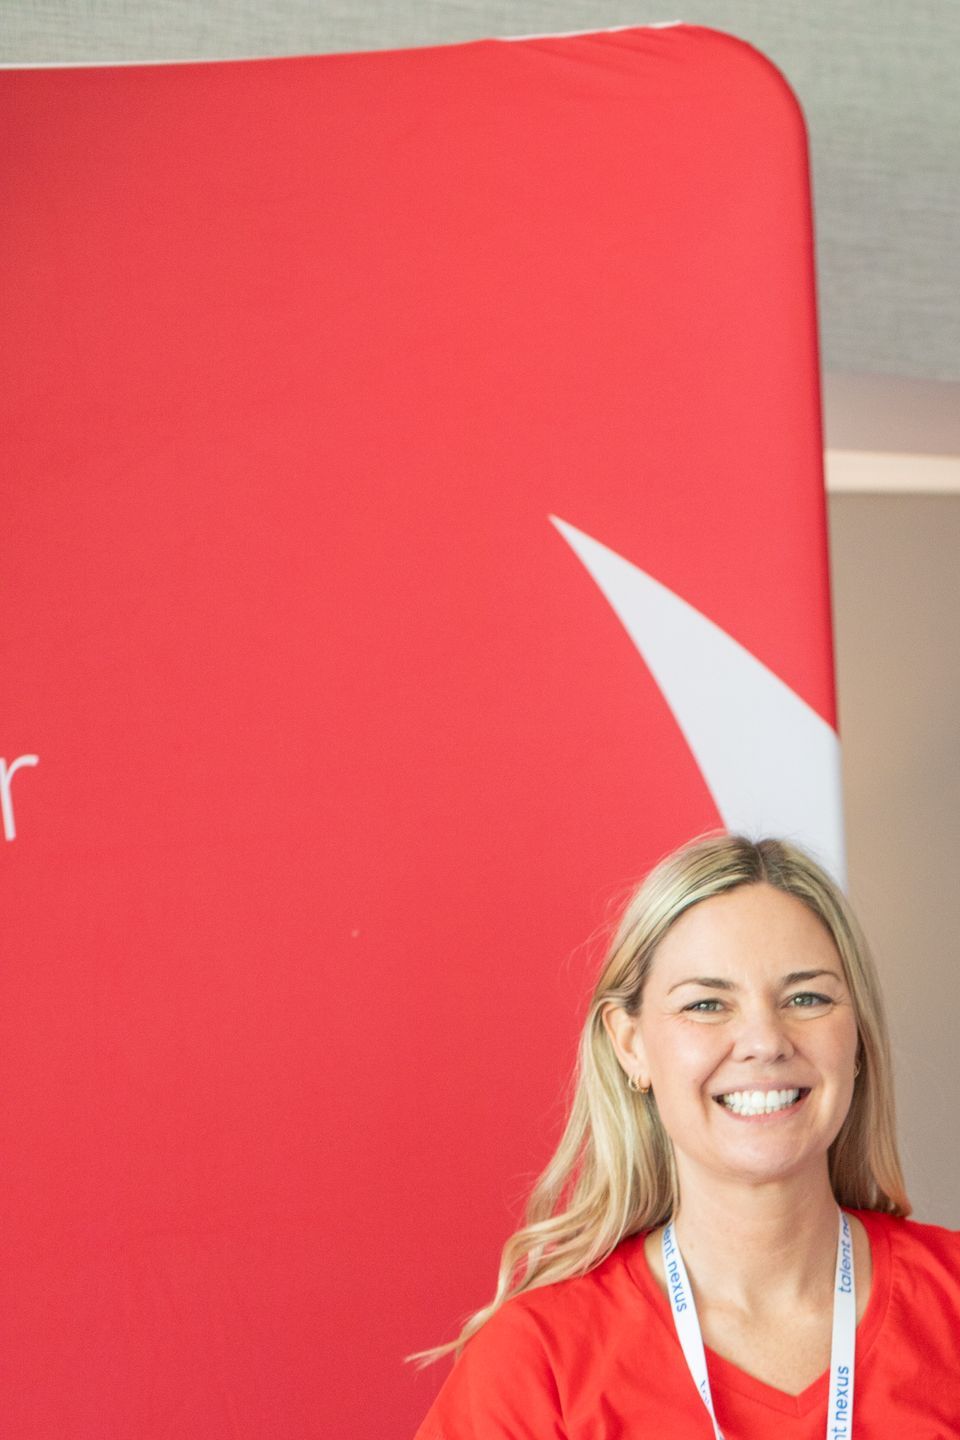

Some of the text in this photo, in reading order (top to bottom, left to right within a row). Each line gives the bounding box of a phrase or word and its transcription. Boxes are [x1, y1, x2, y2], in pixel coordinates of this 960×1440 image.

[667, 1260, 687, 1313] nexus
[838, 1240, 852, 1294] talent
[835, 1365, 850, 1422] nexus
